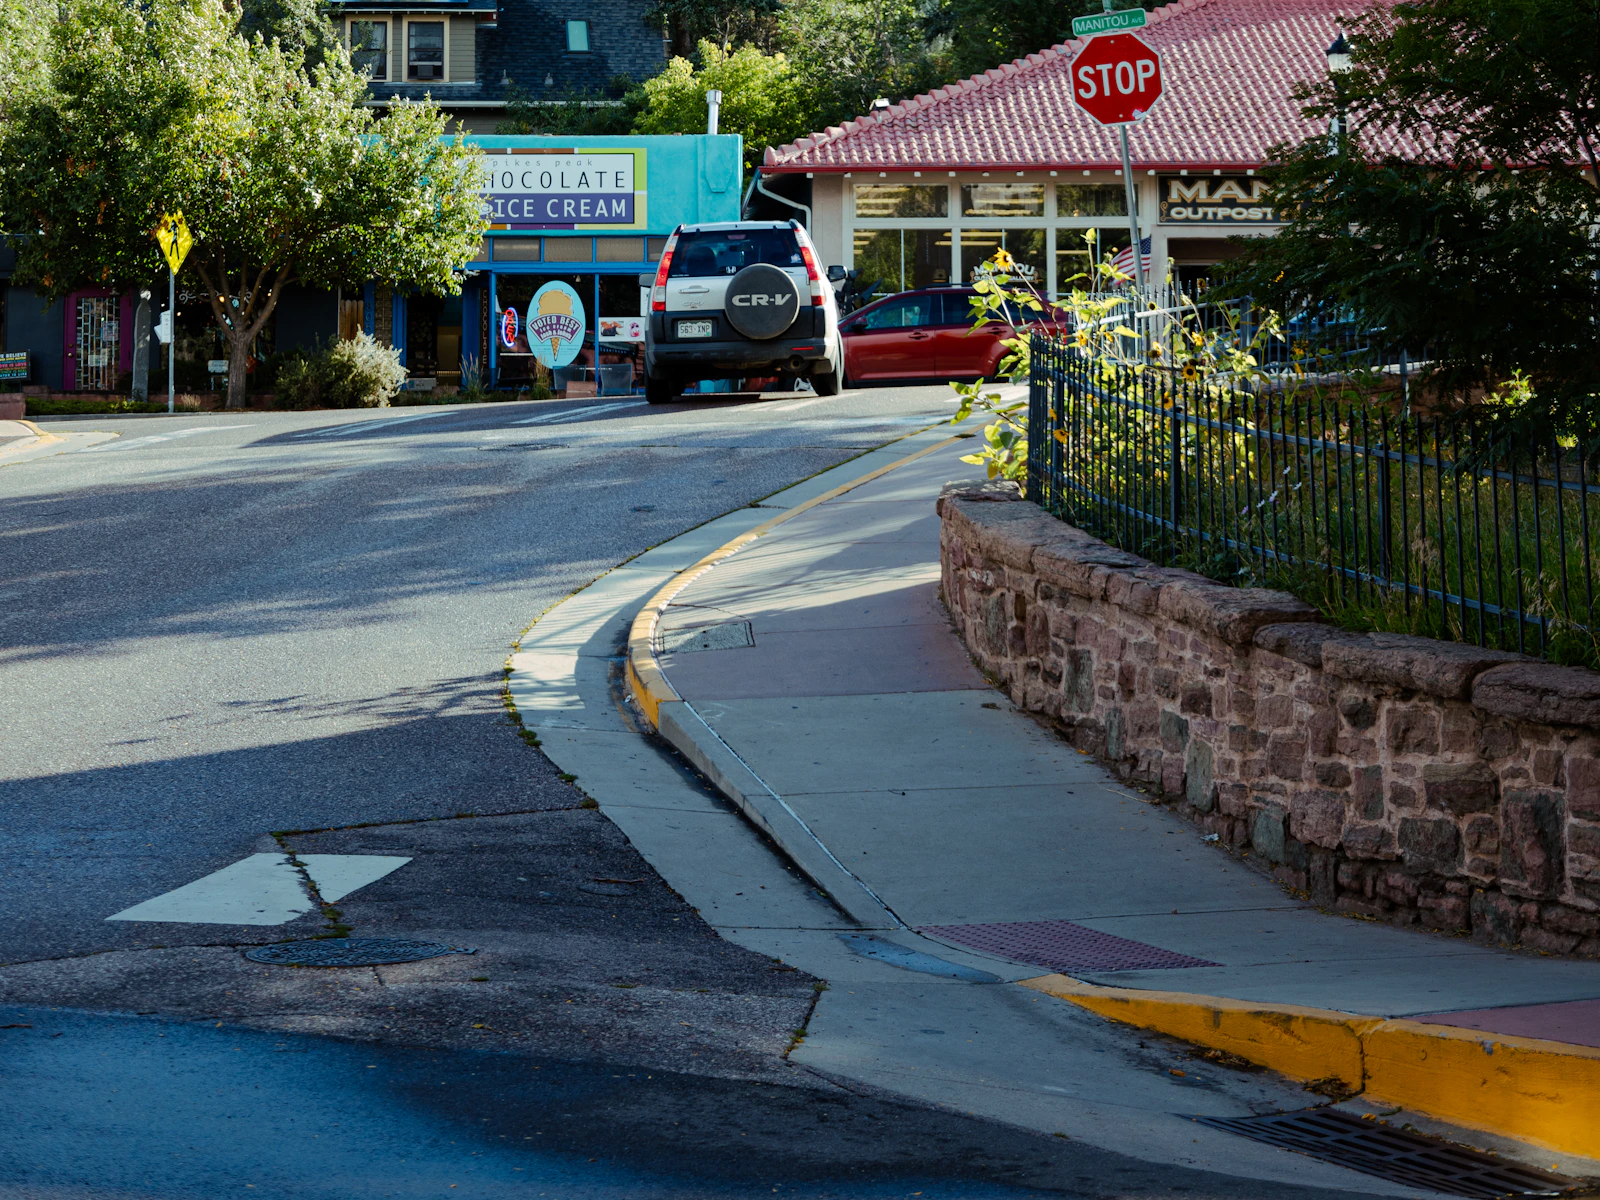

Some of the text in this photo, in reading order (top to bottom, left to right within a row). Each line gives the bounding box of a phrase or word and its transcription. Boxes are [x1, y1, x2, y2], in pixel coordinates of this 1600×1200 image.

[1075, 14, 1143, 32] MANITOU AVE
[1078, 59, 1156, 99] STOP
[492, 158, 593, 168] pikes peak
[483, 171, 625, 189] HOCOLATE
[1167, 178, 1275, 203] MAN
[494, 199, 626, 218] ICE CREAM
[1170, 206, 1274, 221] OUTPOST
[732, 293, 792, 306] CR-V
[505, 309, 515, 343] OPEN
[531, 316, 580, 331] VOTED BEST
